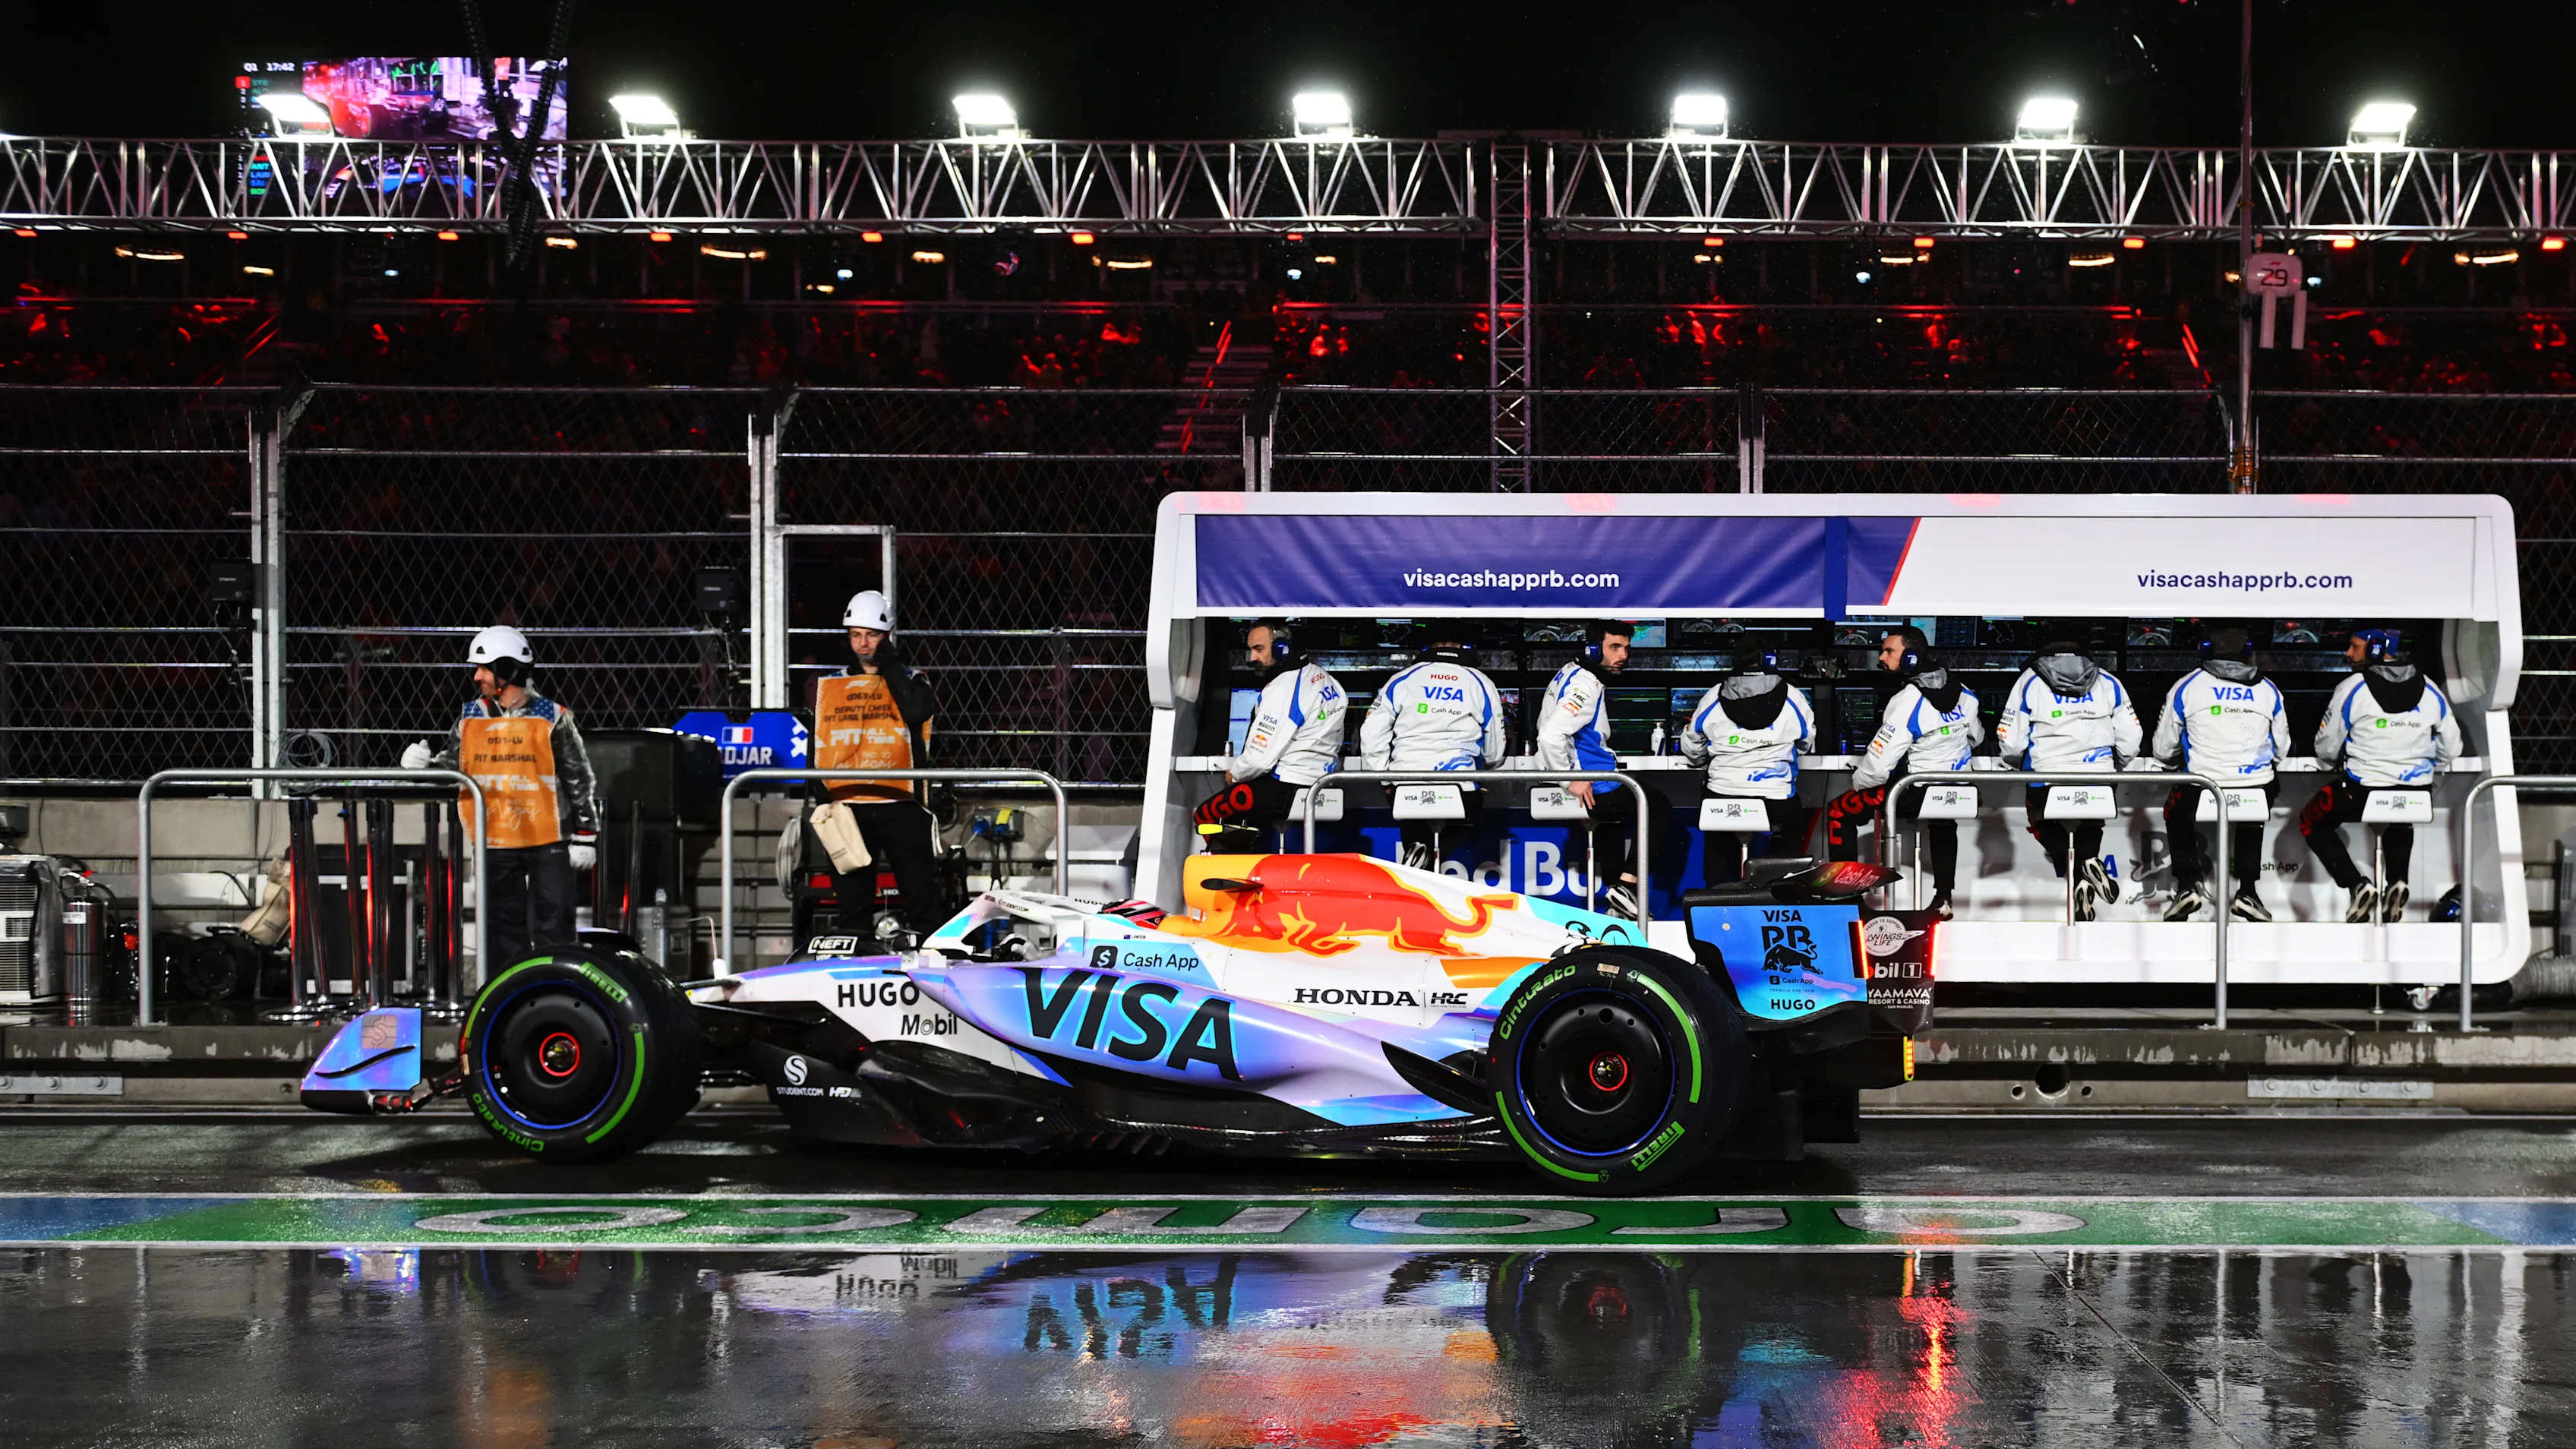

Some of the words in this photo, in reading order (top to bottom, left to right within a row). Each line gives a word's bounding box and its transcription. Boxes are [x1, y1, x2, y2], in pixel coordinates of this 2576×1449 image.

[244, 62, 258, 72] Q1
[267, 62, 295, 71] 17:42
[2261, 268, 2288, 287] 29
[1403, 570, 1619, 591] visacashapprb.com
[2138, 570, 2353, 591] visacashapprb.com
[1421, 686, 1463, 702] VISA
[2211, 687, 2255, 702] VISA
[835, 705, 866, 714] DEPUTY
[1263, 713, 1278, 726] VISA
[830, 728, 866, 747] PIT
[867, 728, 886, 737] ALL
[1741, 736, 1758, 744] Cash
[474, 753, 488, 762] PIT
[491, 753, 538, 763] MARSHAL
[2277, 862, 2299, 873] App
[1834, 866, 1864, 886] Cash
[1856, 870, 1880, 890] App
[1760, 910, 1802, 922] VISA
[1865, 920, 1879, 932] PROUD
[1886, 918, 1902, 931] SUPPORT
[813, 939, 851, 949] NEFT
[1123, 952, 1162, 968] Cash
[1166, 954, 1200, 972] App
[579, 961, 629, 1003] PIRELLI
[838, 982, 920, 1007] HUGO
[1293, 989, 1420, 1007] HONDA
[1431, 992, 1468, 1005] HRC
[1499, 964, 1576, 1040] Cinturato
[1771, 999, 1816, 1010] HUGO
[901, 1013, 958, 1035] Mobil
[1015, 968, 1243, 1081] VISA
[776, 1086, 824, 1097] STUDENT.COM
[472, 1093, 545, 1153] Cinturato
[1631, 1120, 1685, 1172] PIRELLI
[414, 1206, 2088, 1236] aramco
